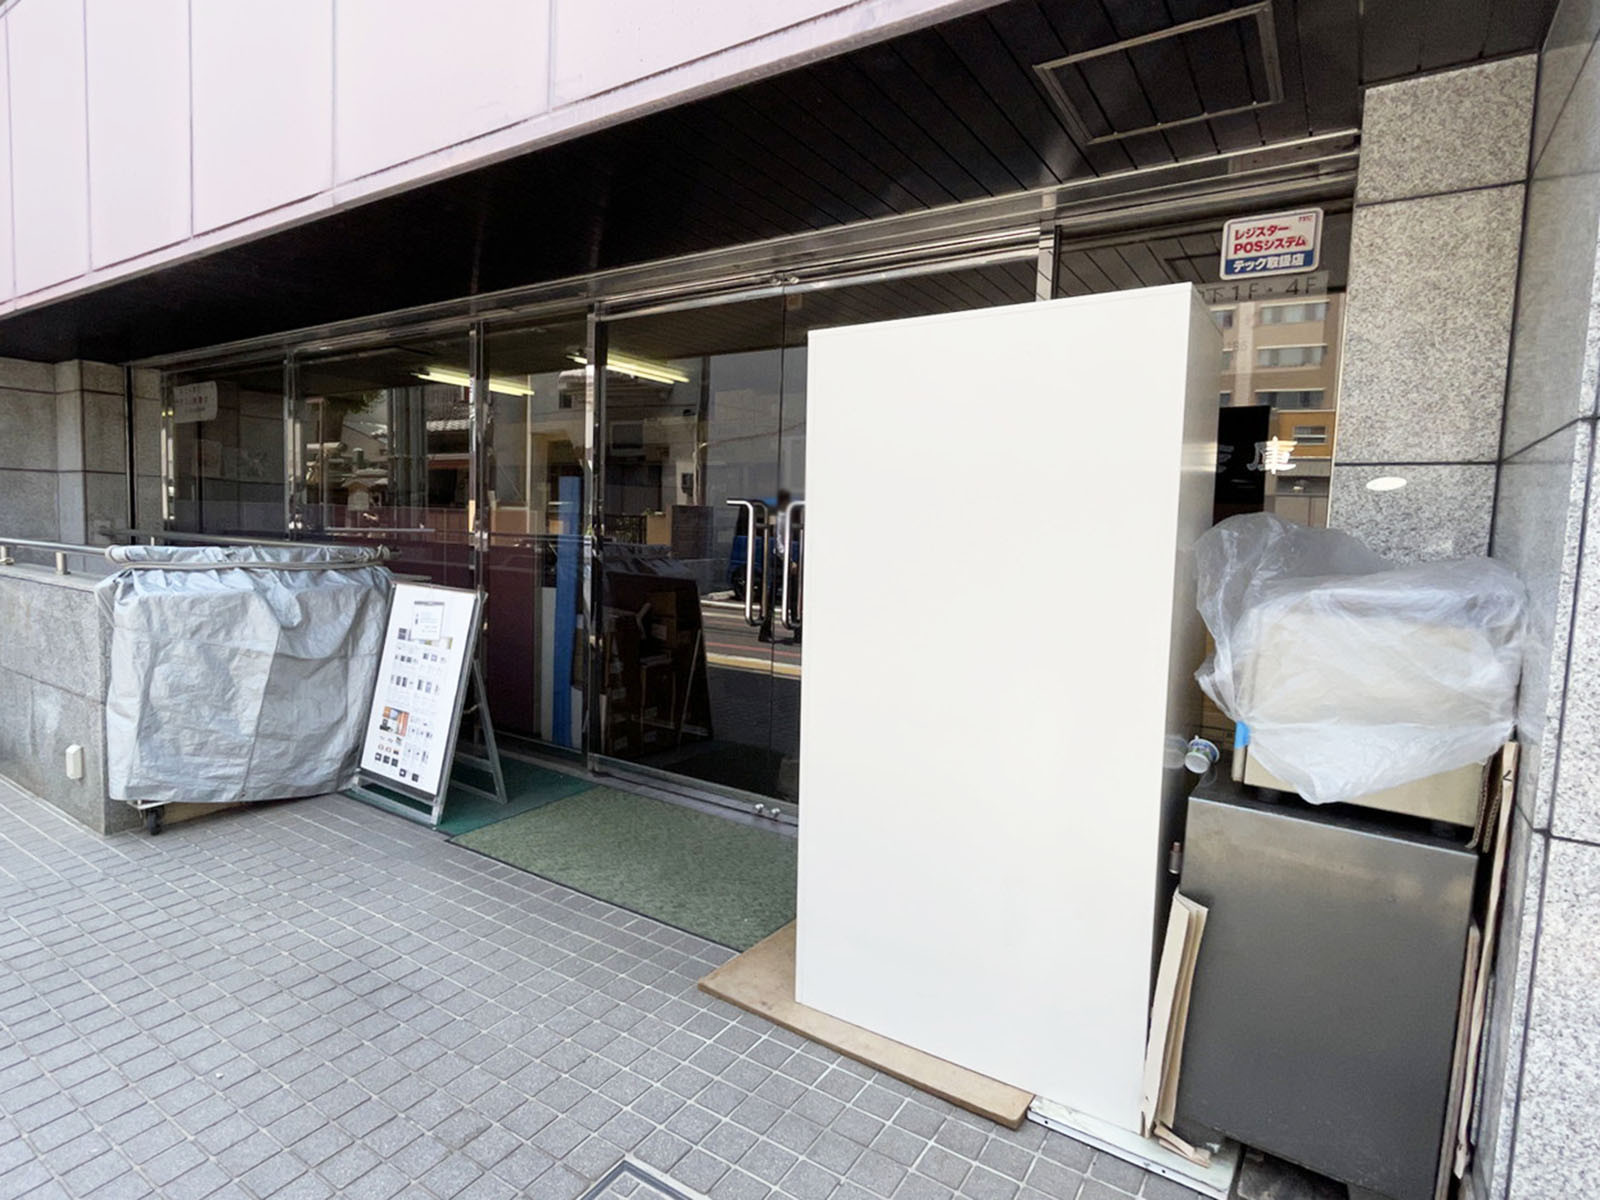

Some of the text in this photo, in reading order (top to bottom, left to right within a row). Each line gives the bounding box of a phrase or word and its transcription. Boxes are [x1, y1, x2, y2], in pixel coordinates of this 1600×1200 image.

[1235, 225, 1290, 241] レジスター
[1233, 235, 1306, 254] POSシステム
[1233, 253, 1304, 273] テック取扱店
